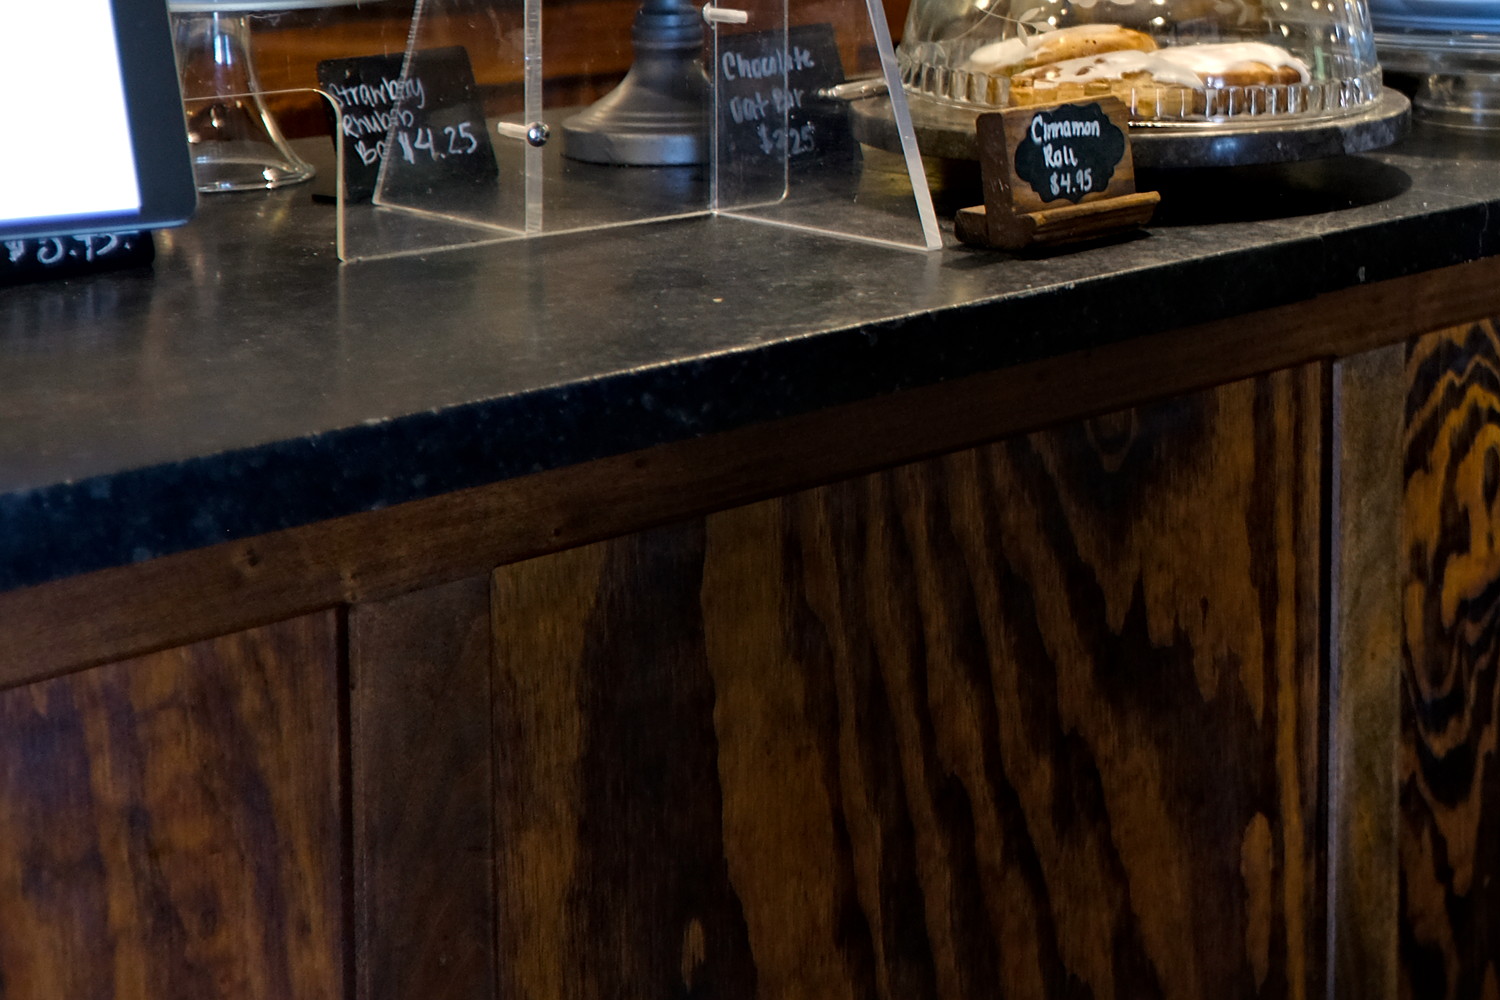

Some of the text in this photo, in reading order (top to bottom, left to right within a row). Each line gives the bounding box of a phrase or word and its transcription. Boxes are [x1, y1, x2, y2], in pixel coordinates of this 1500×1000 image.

[354, 121, 478, 167] Ba $4.25
[1030, 113, 1101, 145] Cinnamon
[1042, 142, 1079, 168] Roll
[1049, 167, 1093, 196] $4.95
